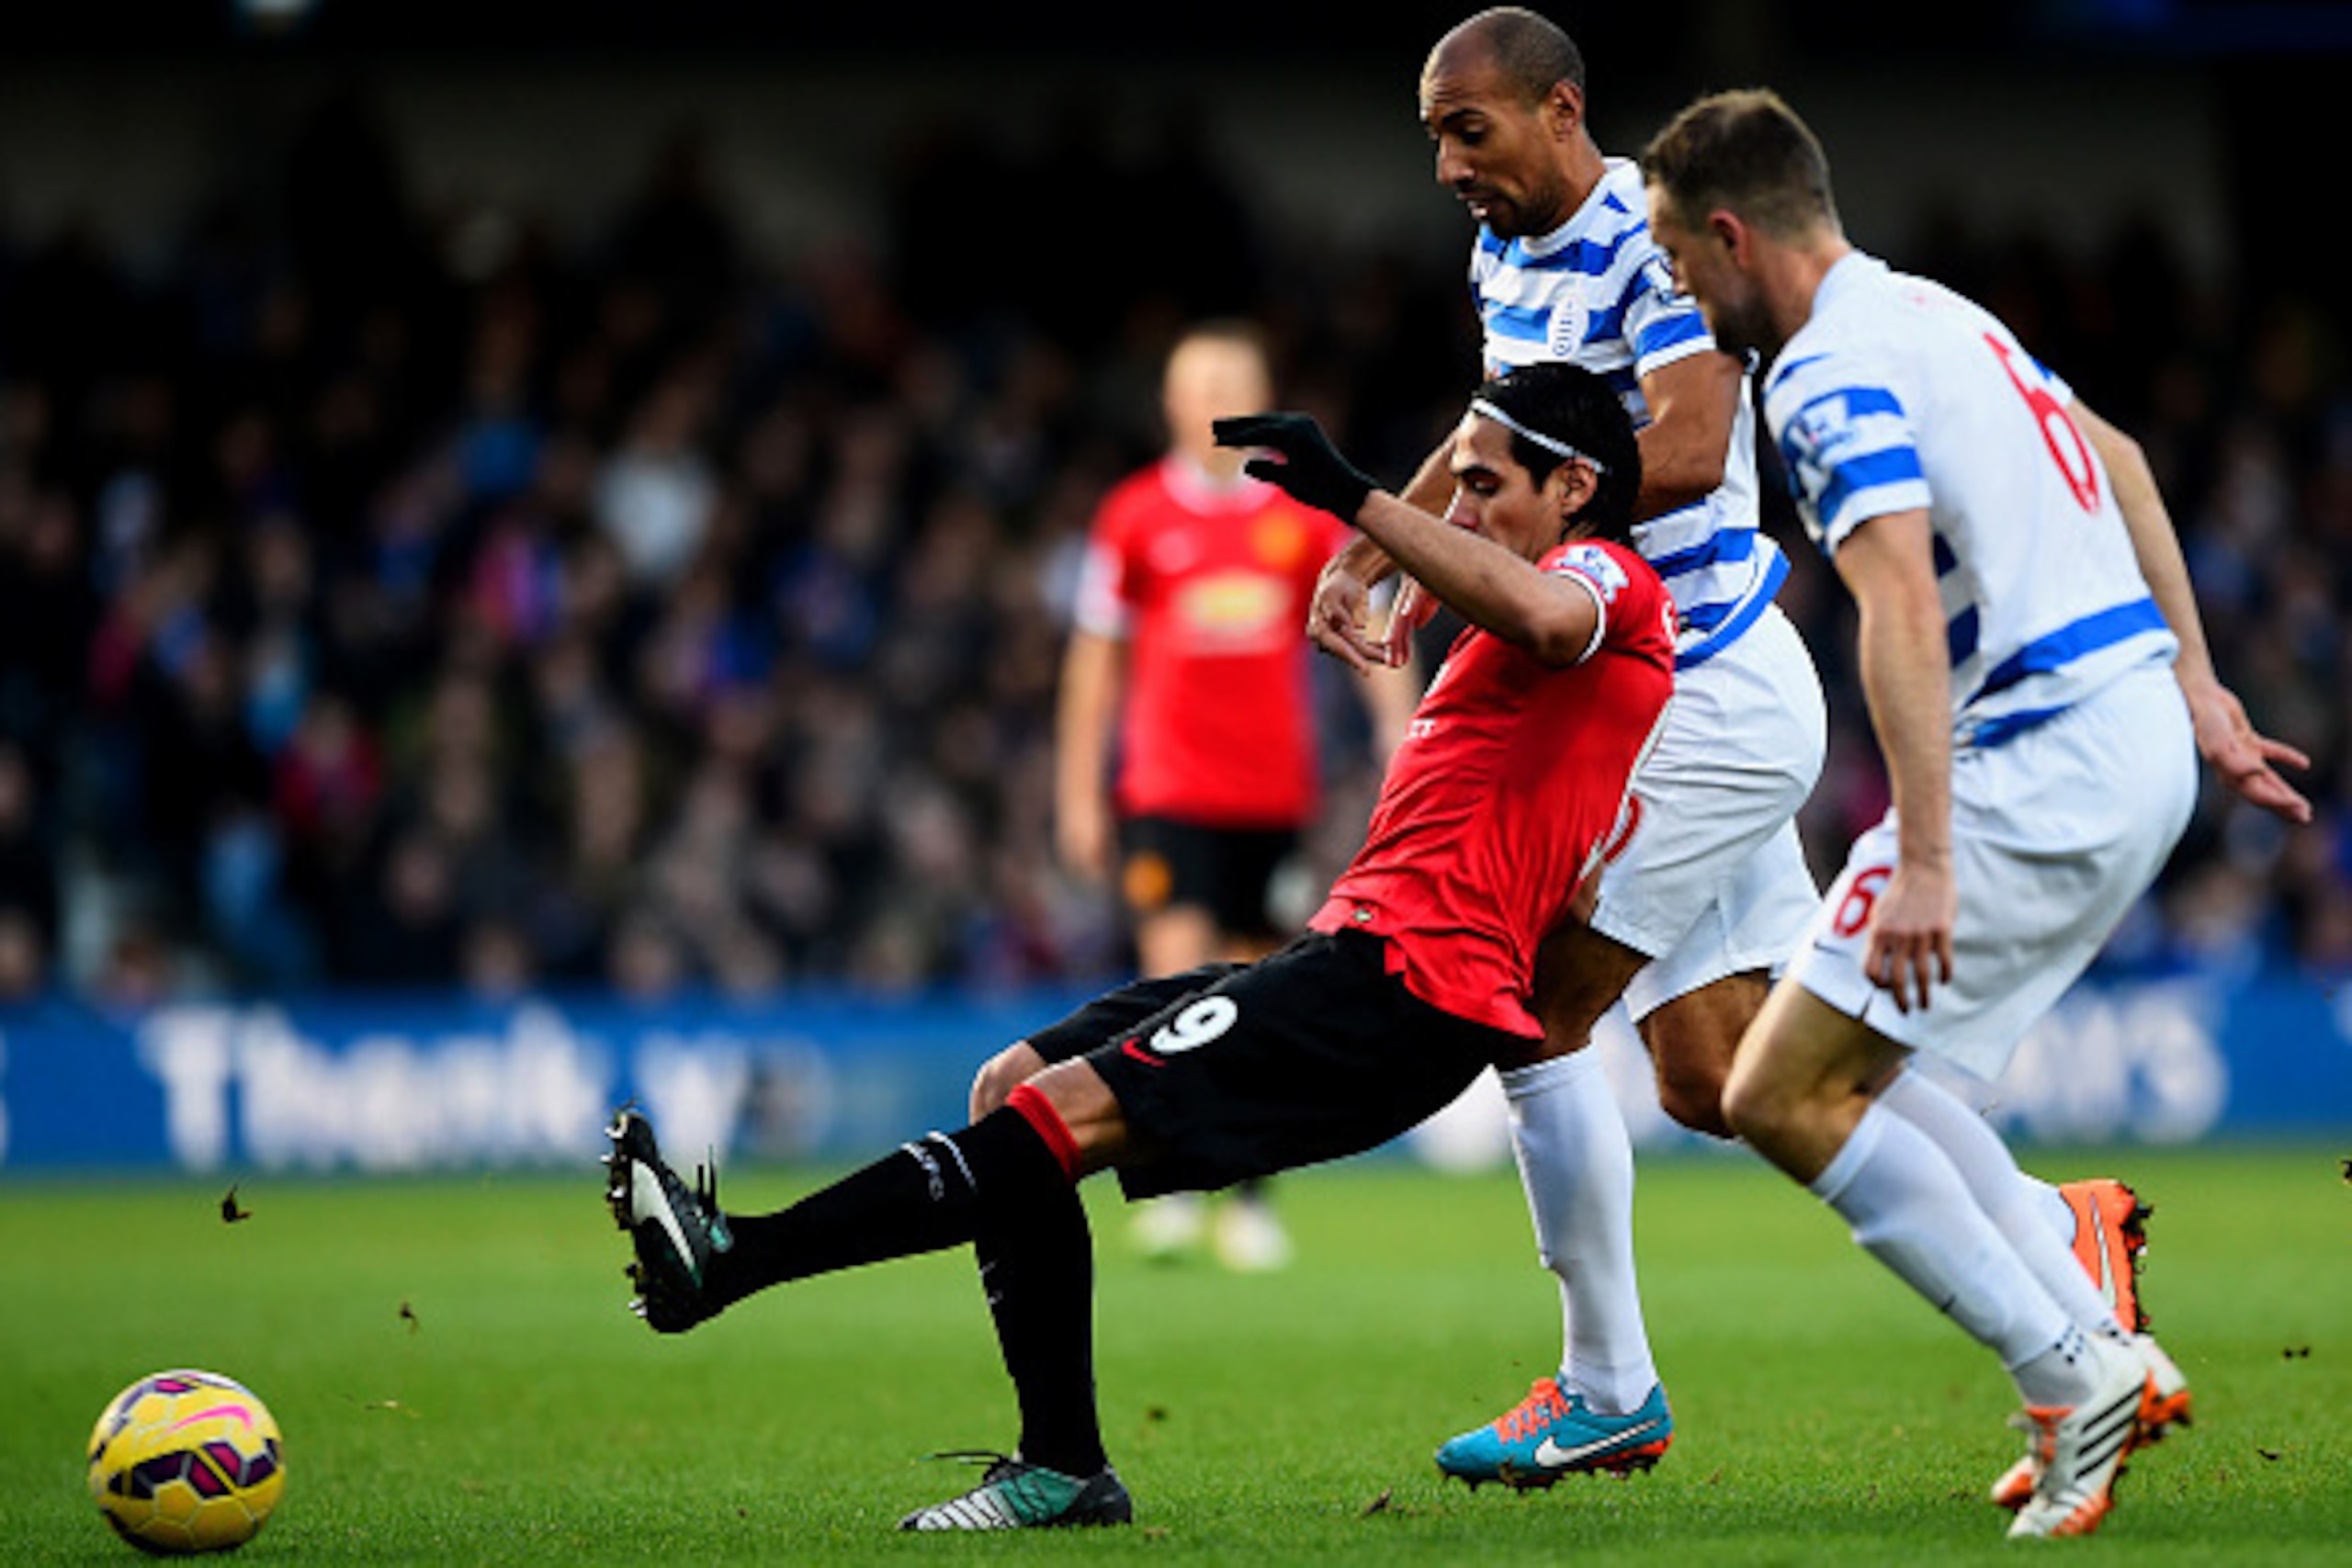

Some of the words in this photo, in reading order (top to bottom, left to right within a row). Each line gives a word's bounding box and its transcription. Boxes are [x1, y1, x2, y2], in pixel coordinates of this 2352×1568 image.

[1984, 332, 2101, 515] 6
[1833, 862, 1894, 939] 6
[1149, 995, 1238, 1054] 9
[137, 1004, 612, 1169] Thank
